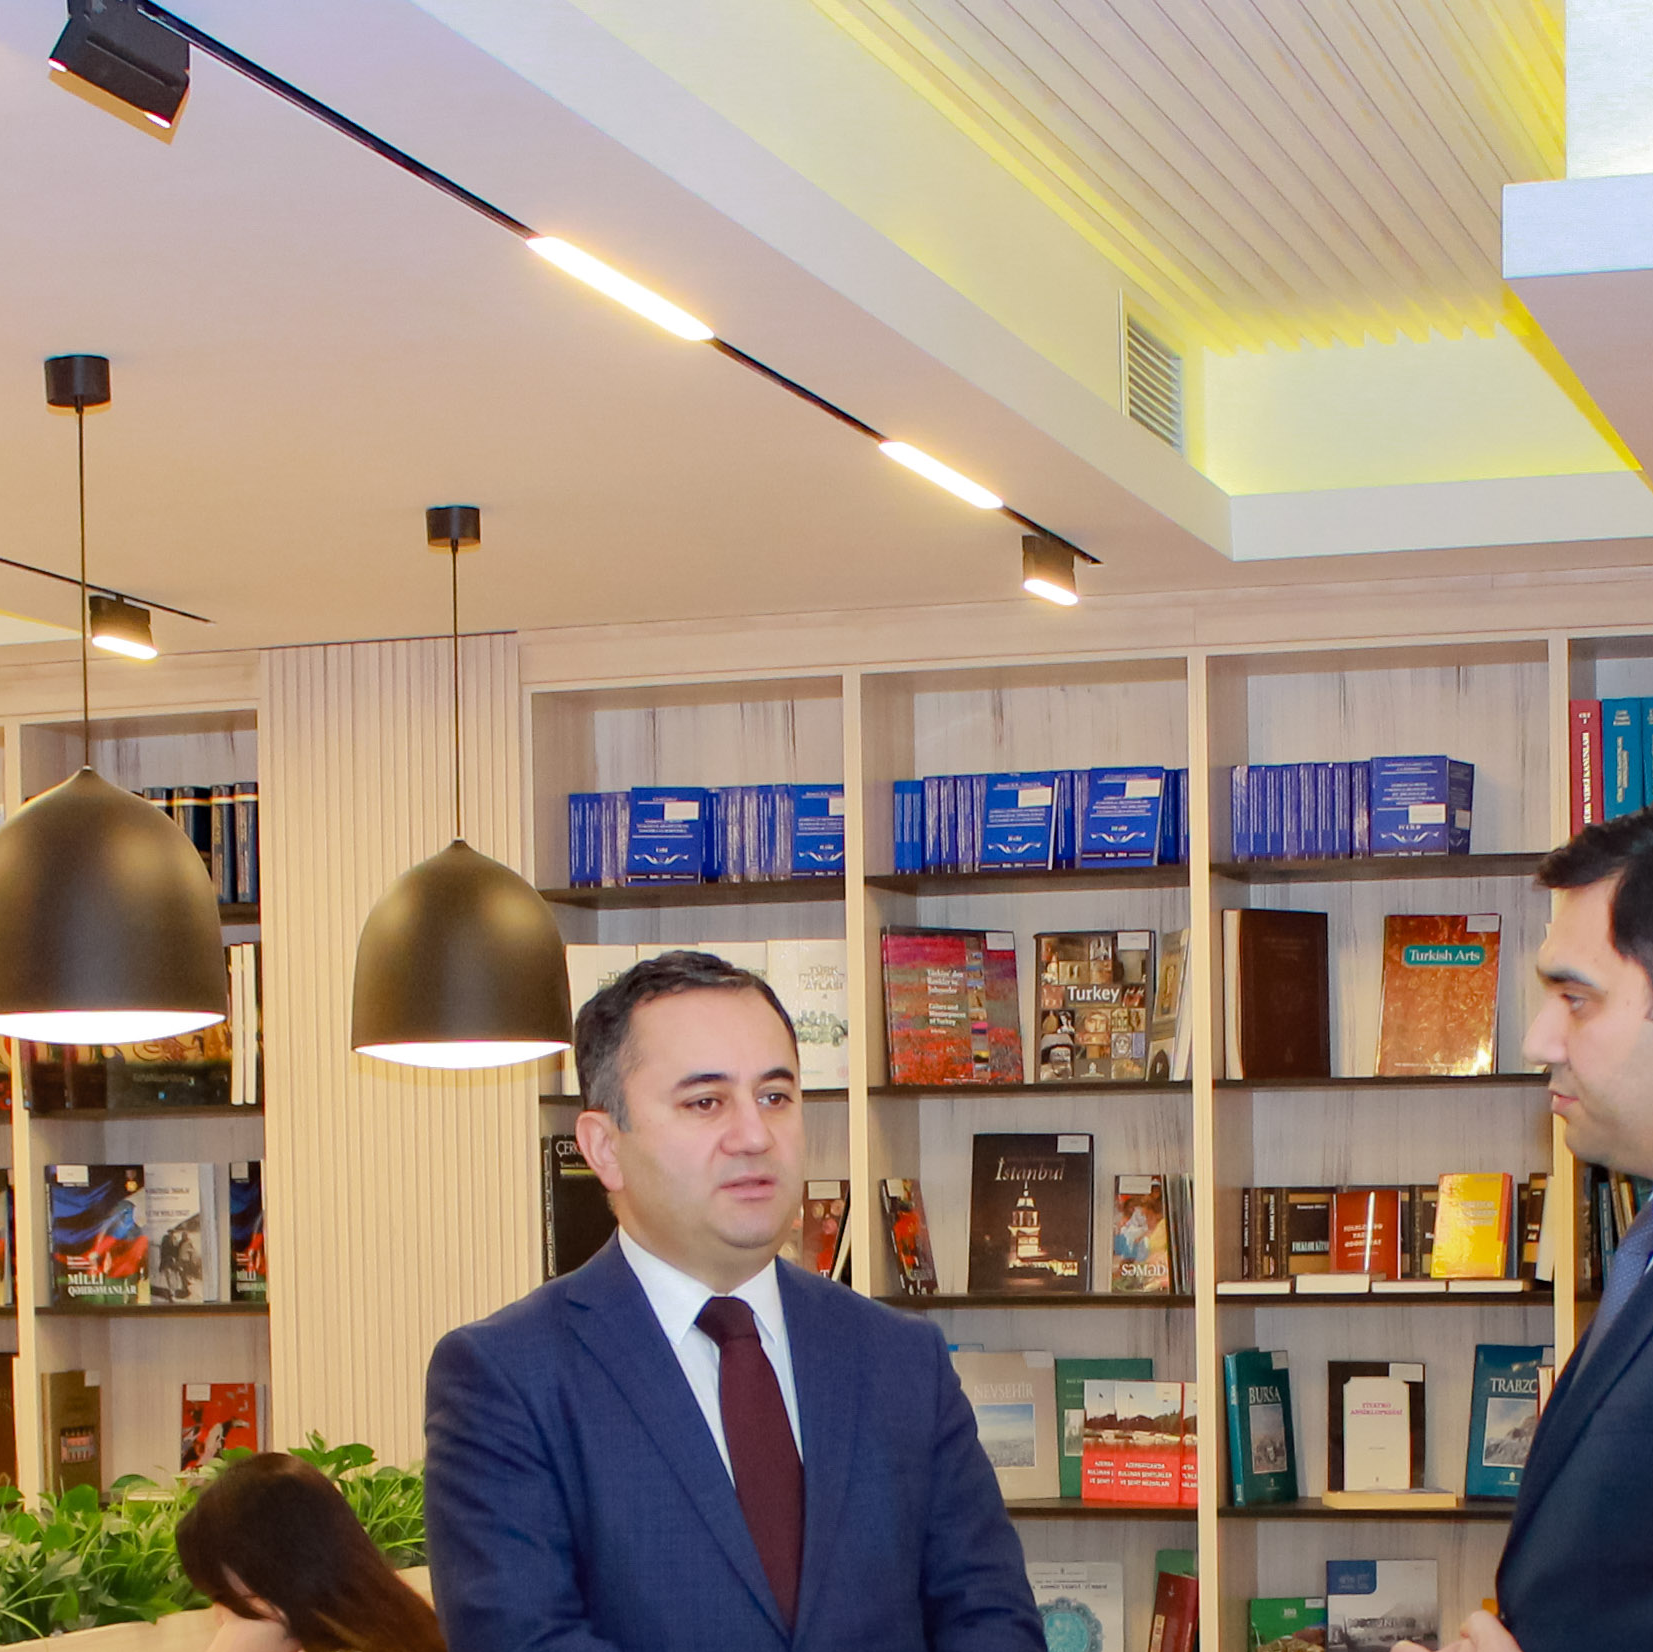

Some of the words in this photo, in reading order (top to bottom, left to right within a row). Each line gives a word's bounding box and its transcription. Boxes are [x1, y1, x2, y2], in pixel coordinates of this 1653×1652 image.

[1409, 948, 1452, 962] Turkish
[1454, 949, 1480, 962] Arts
[1067, 985, 1120, 1003] Turkey
[995, 1156, 1064, 1181] İstanbul
[1121, 1263, 1166, 1277] SƏMƏD
[67, 1272, 104, 1286] MİLLİ
[973, 1381, 1035, 1401] NEVŞEHİR
[1489, 1377, 1538, 1394] TRABZO
[1248, 1386, 1281, 1405] BURSA
